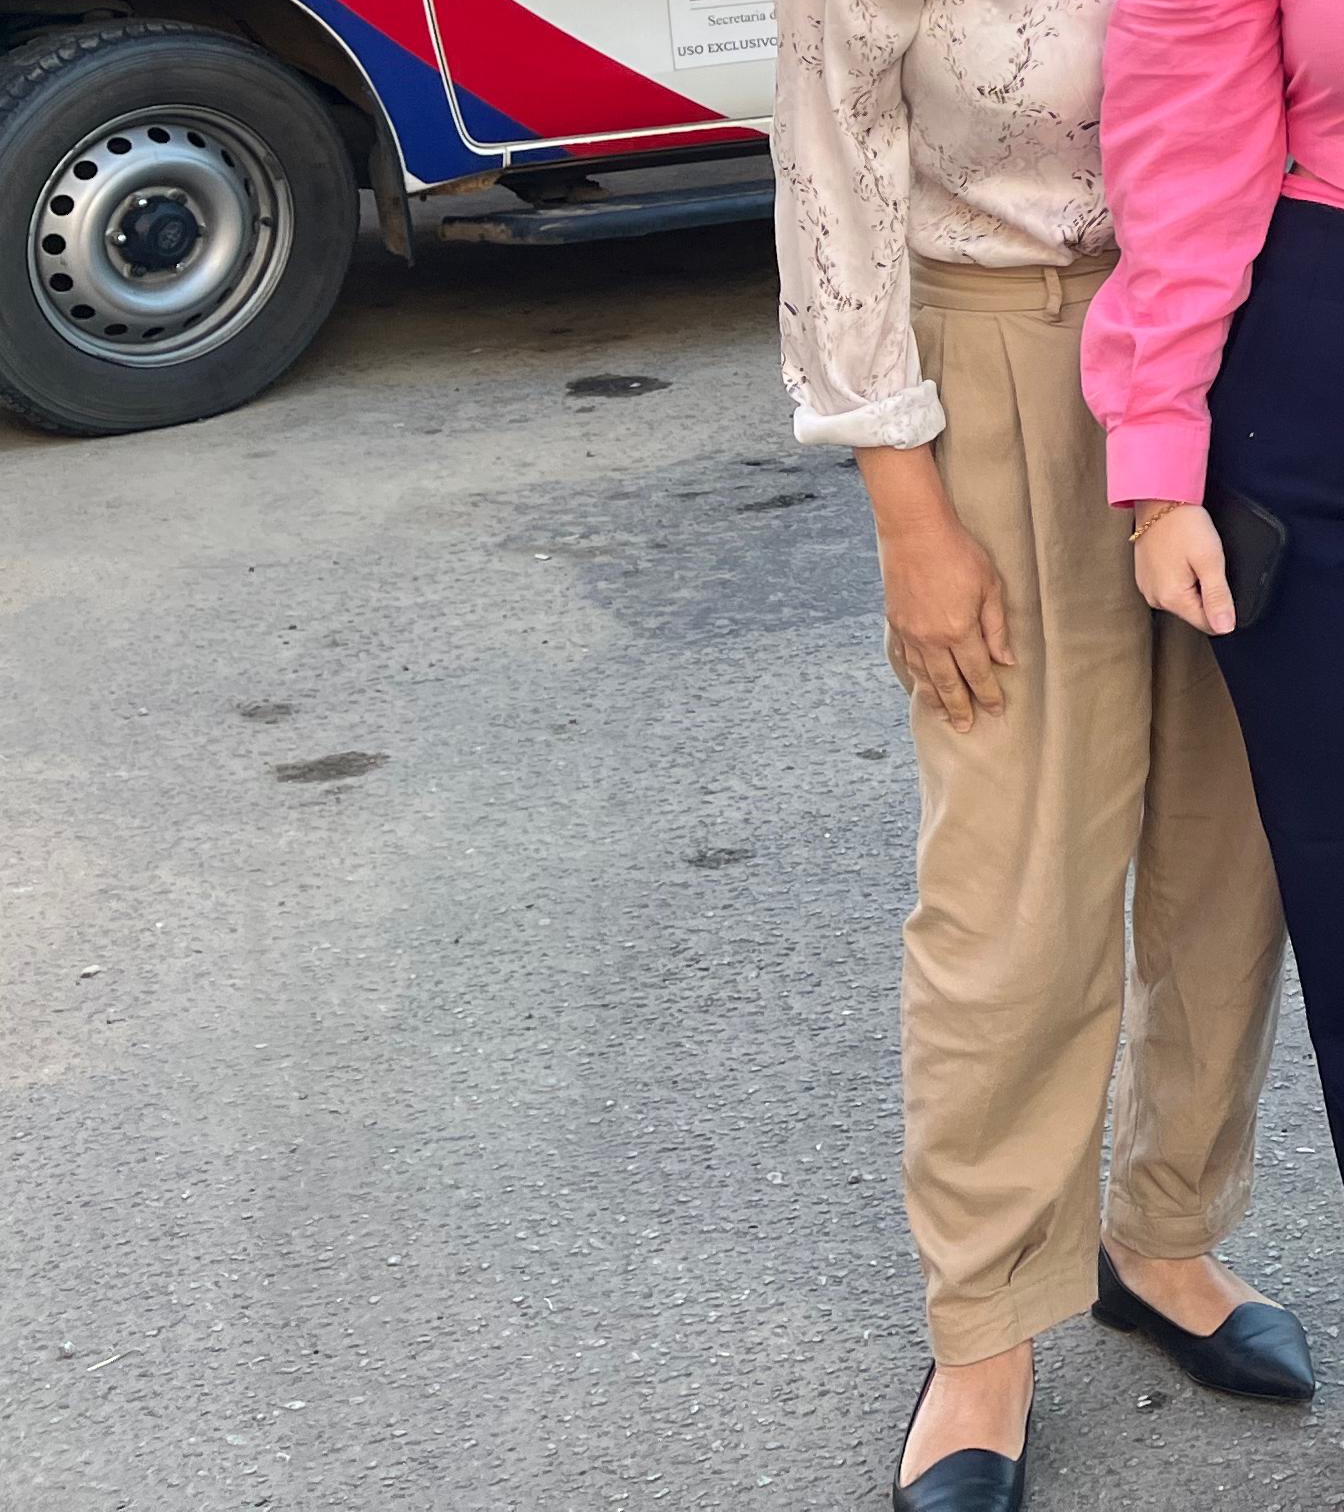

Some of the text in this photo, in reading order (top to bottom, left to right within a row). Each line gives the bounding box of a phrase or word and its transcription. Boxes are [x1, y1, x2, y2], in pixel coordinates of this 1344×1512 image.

[708, 11, 766, 26] Secretaria
[677, 37, 778, 57] USO EXCLUSIVO
